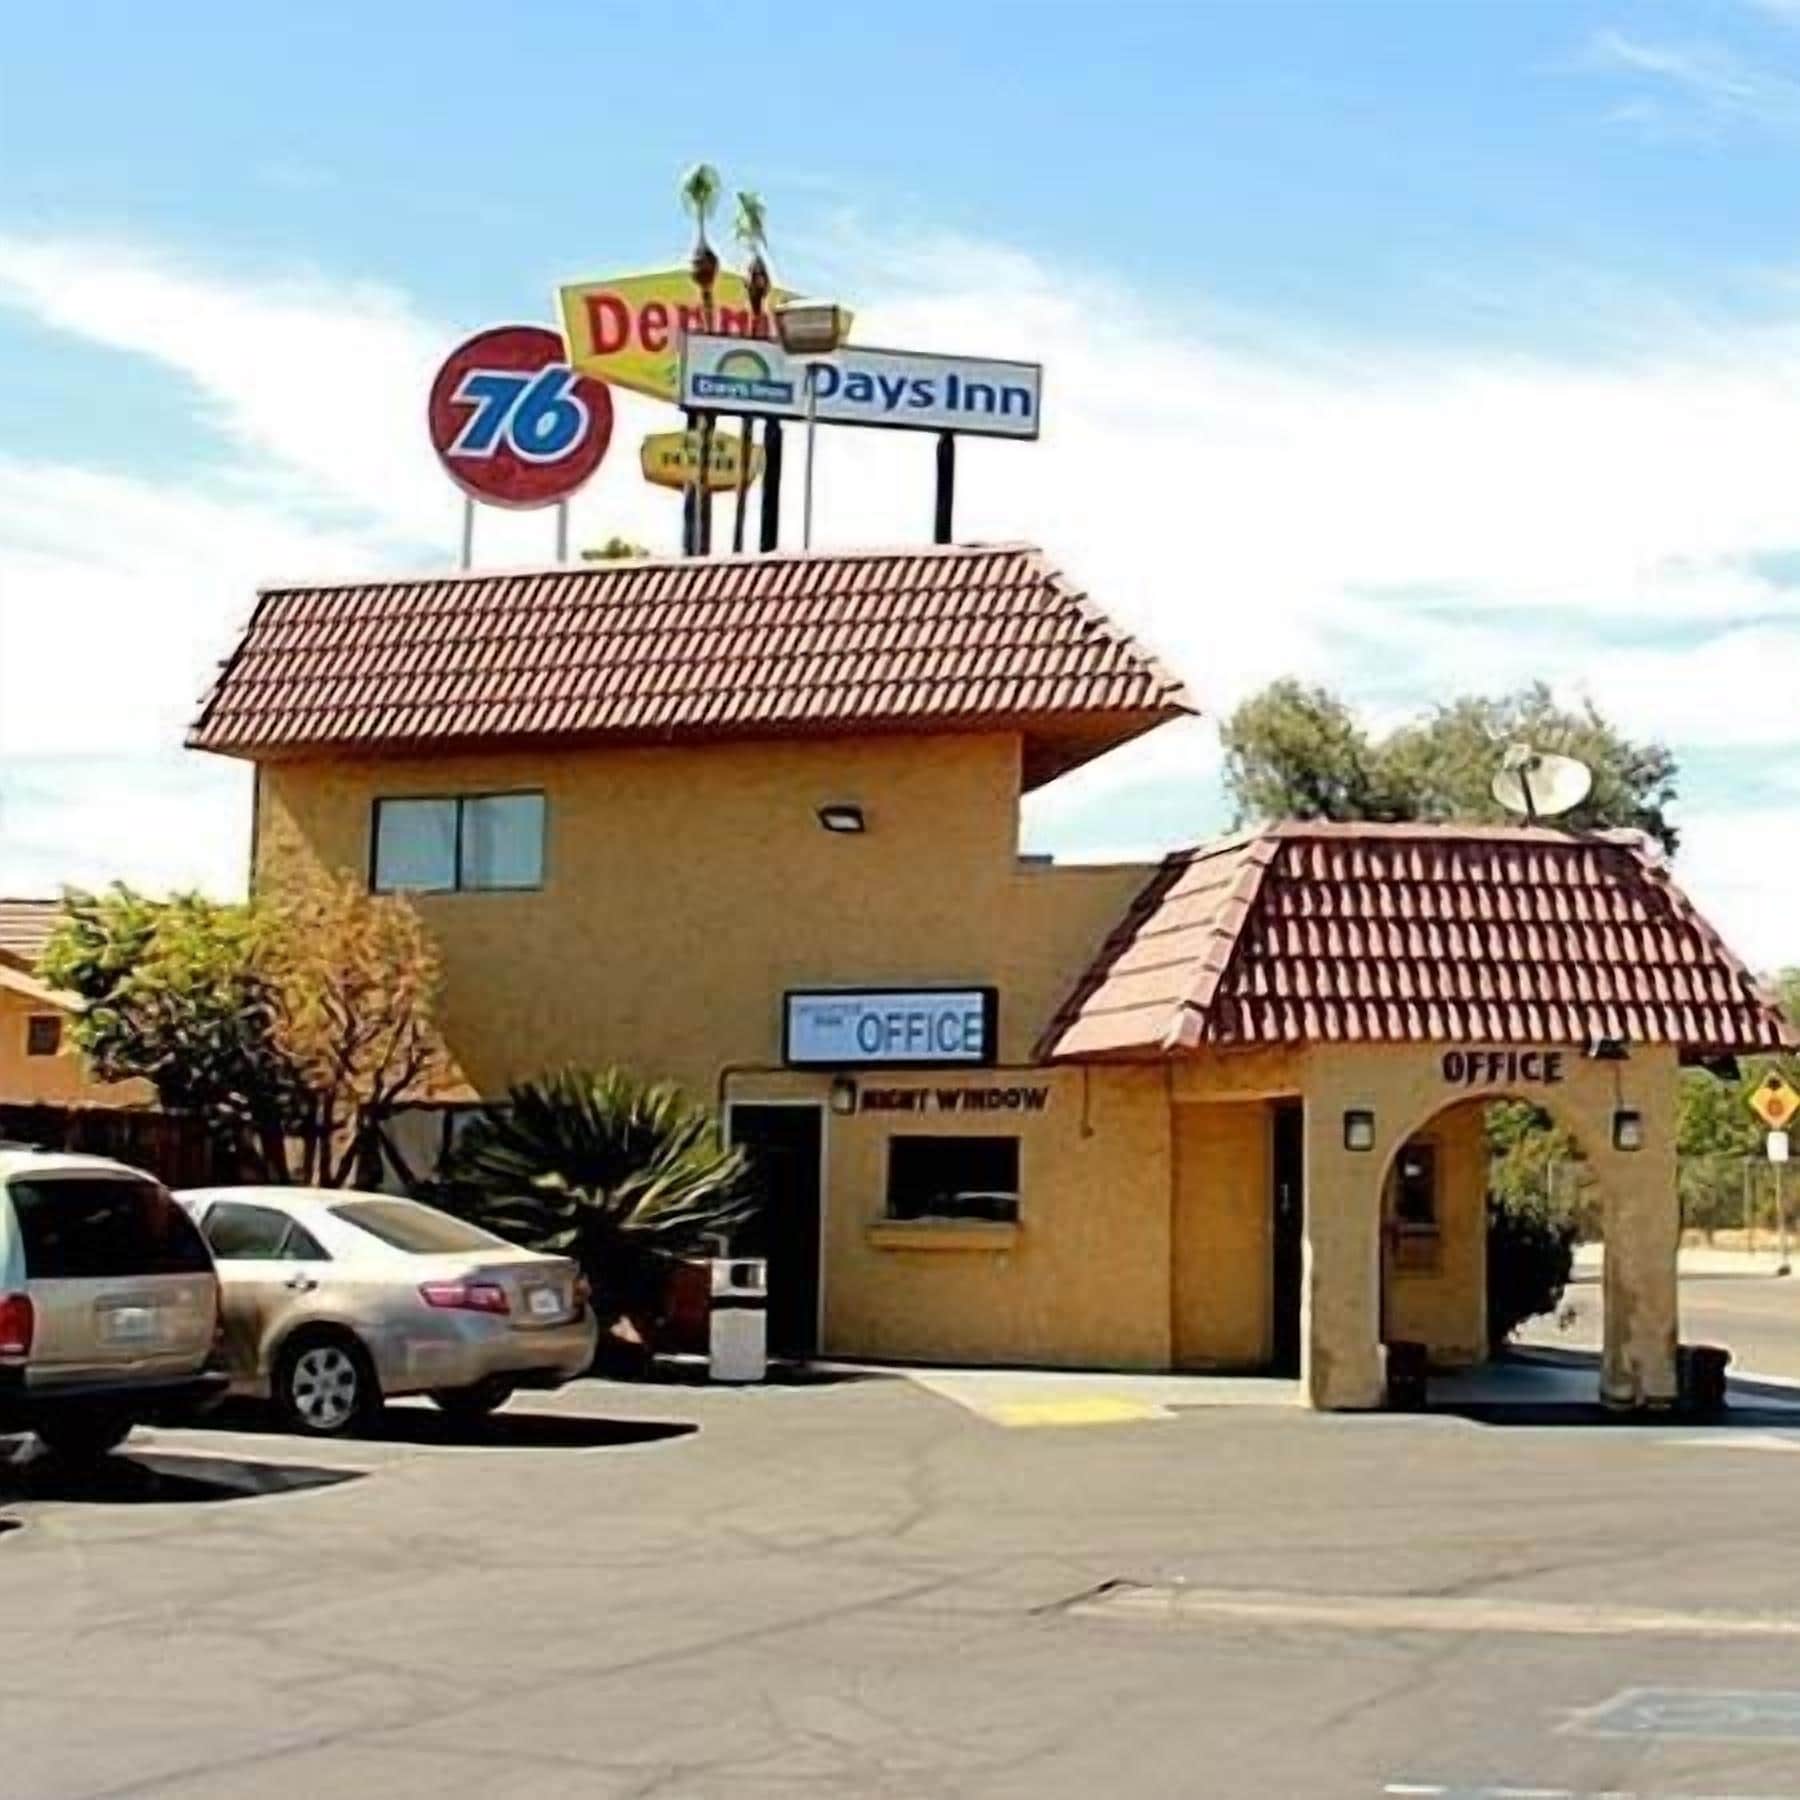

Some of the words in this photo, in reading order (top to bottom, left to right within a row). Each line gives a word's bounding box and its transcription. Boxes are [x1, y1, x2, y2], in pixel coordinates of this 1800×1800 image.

[805, 363, 935, 411] Days
[946, 374, 1031, 417] Inn
[450, 364, 588, 462] 76
[857, 1013, 982, 1053] OFFICE
[1443, 1052, 1563, 1084] OFFICE
[936, 1087, 1050, 1112] WINDOW
